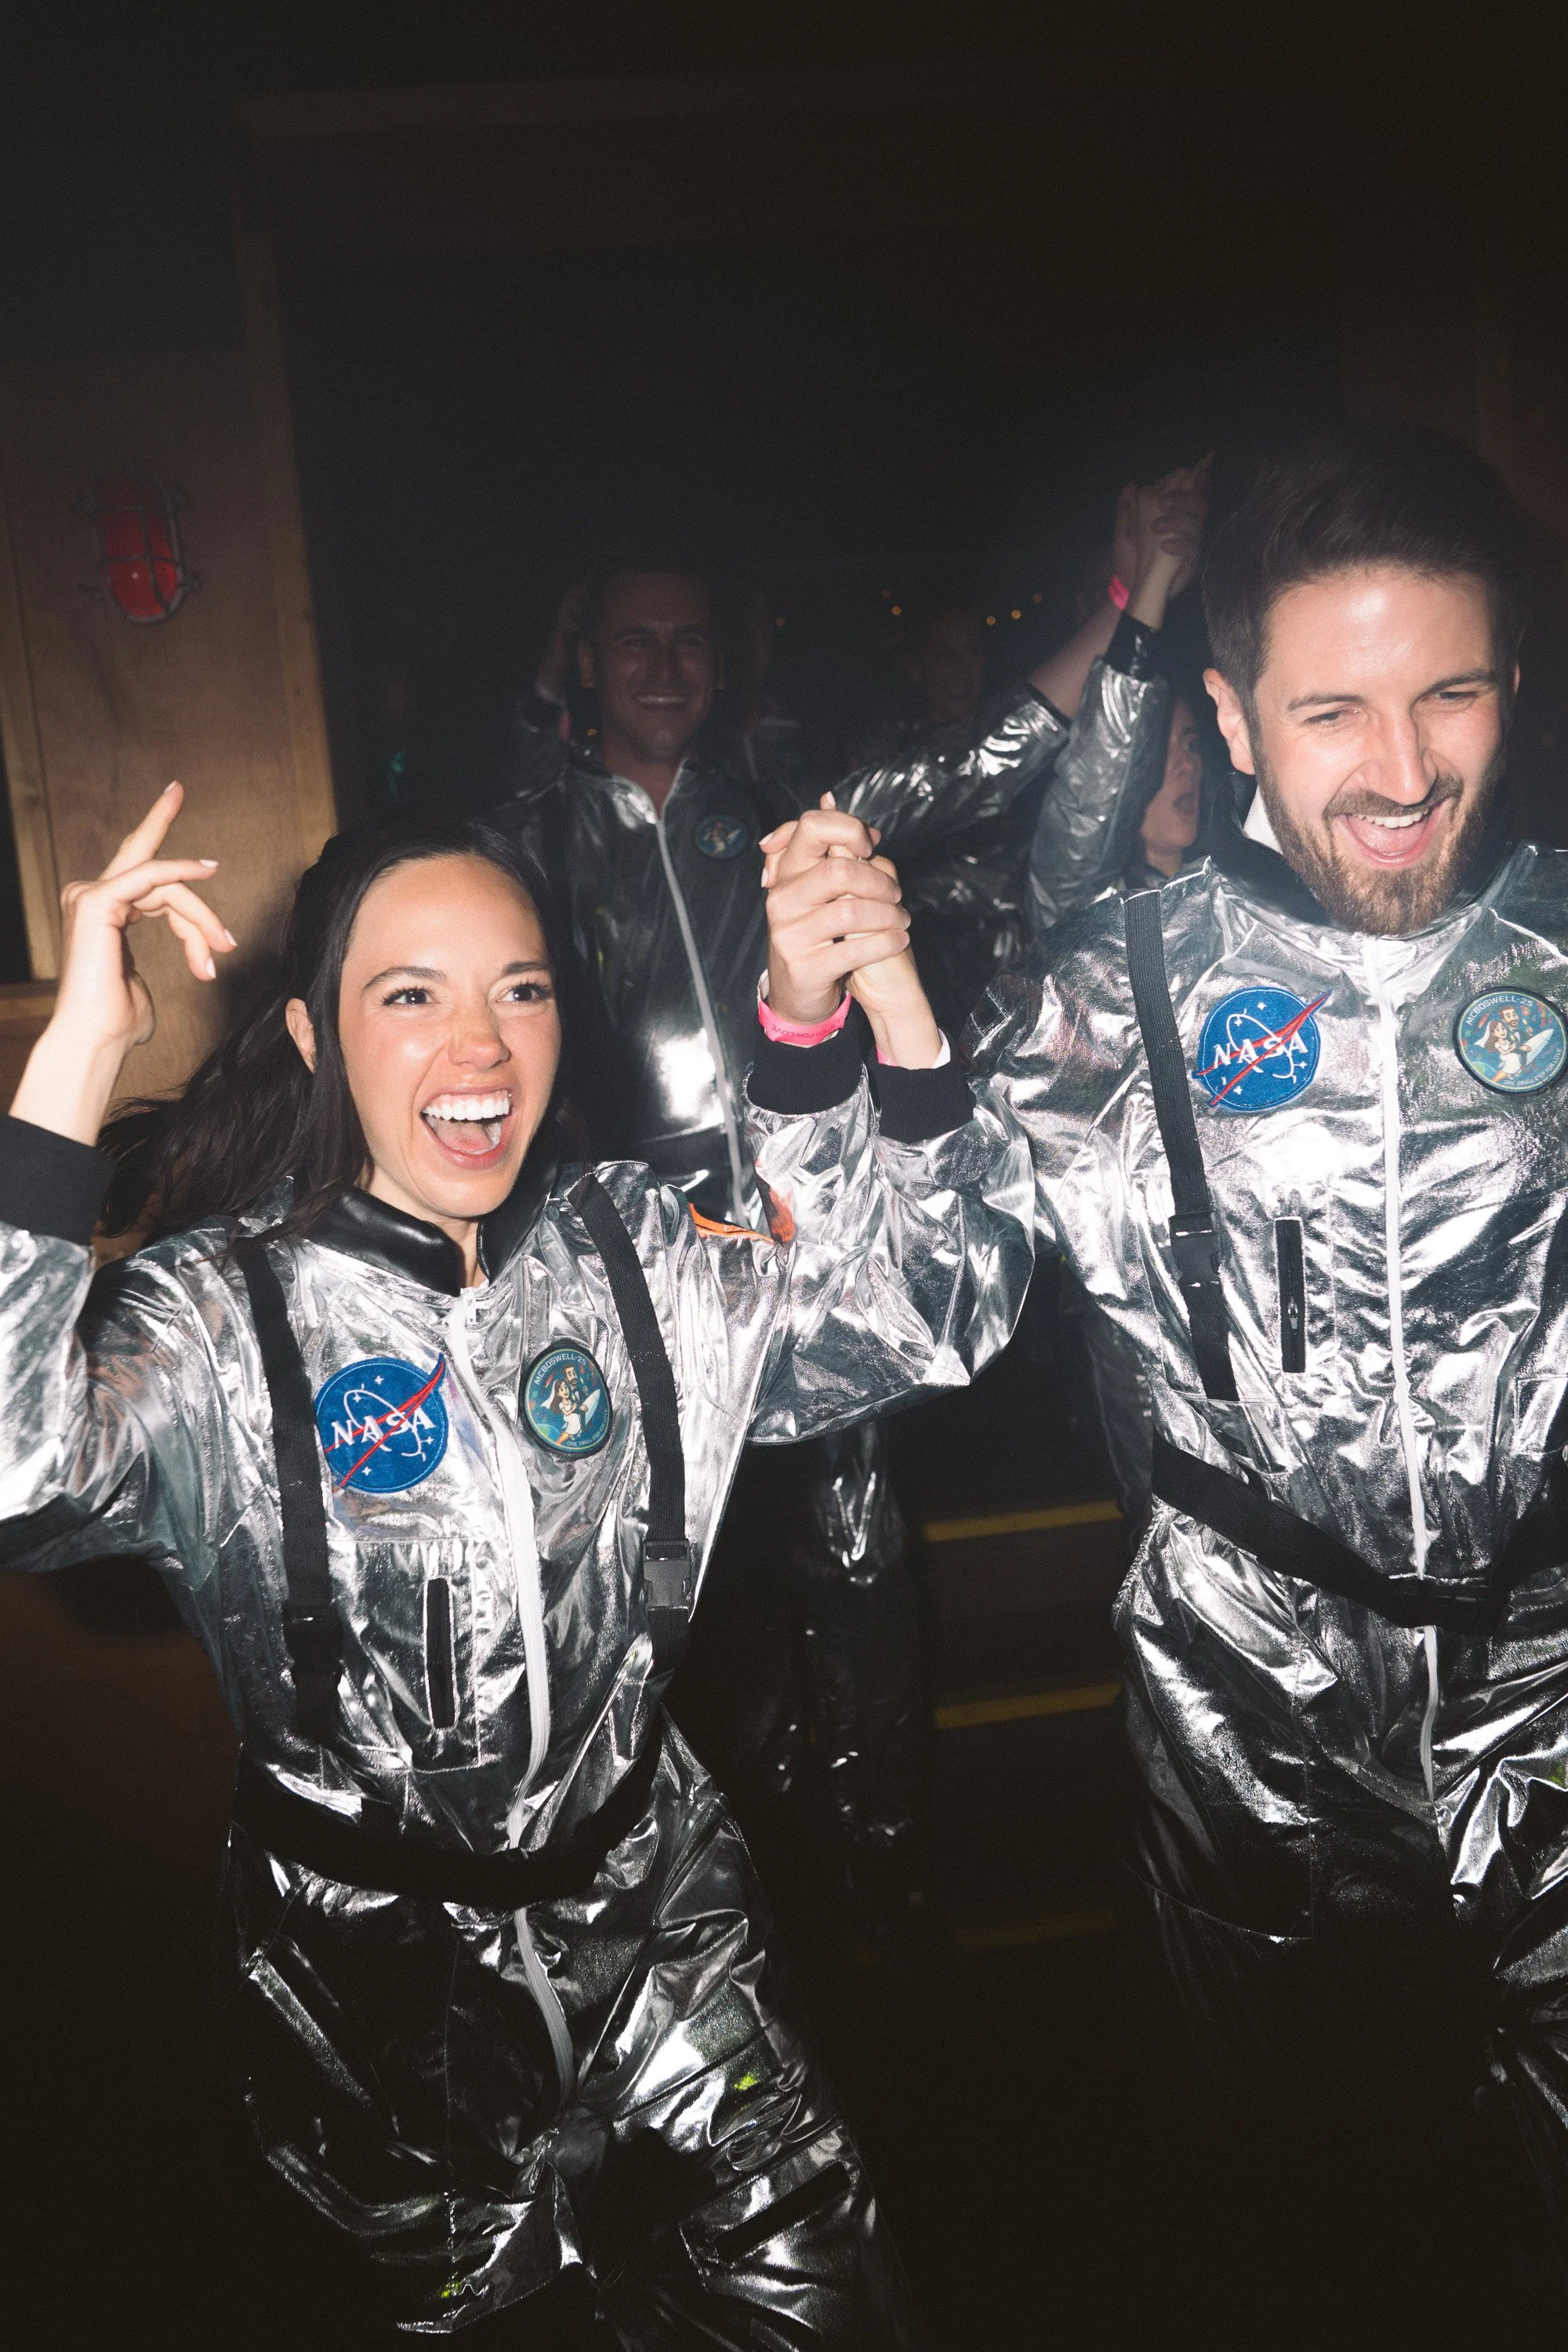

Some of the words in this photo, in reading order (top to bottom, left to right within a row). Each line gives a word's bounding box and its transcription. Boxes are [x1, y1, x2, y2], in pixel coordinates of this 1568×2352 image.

[1466, 996, 1534, 1025] MCBOSWELL-25
[771, 1023, 795, 1036] LOVE
[1214, 1030, 1308, 1069] NASA
[1552, 1048, 1563, 1064] LOVE
[534, 1352, 586, 1385] MCBOSWELL-25
[331, 1406, 437, 1450] NASA
